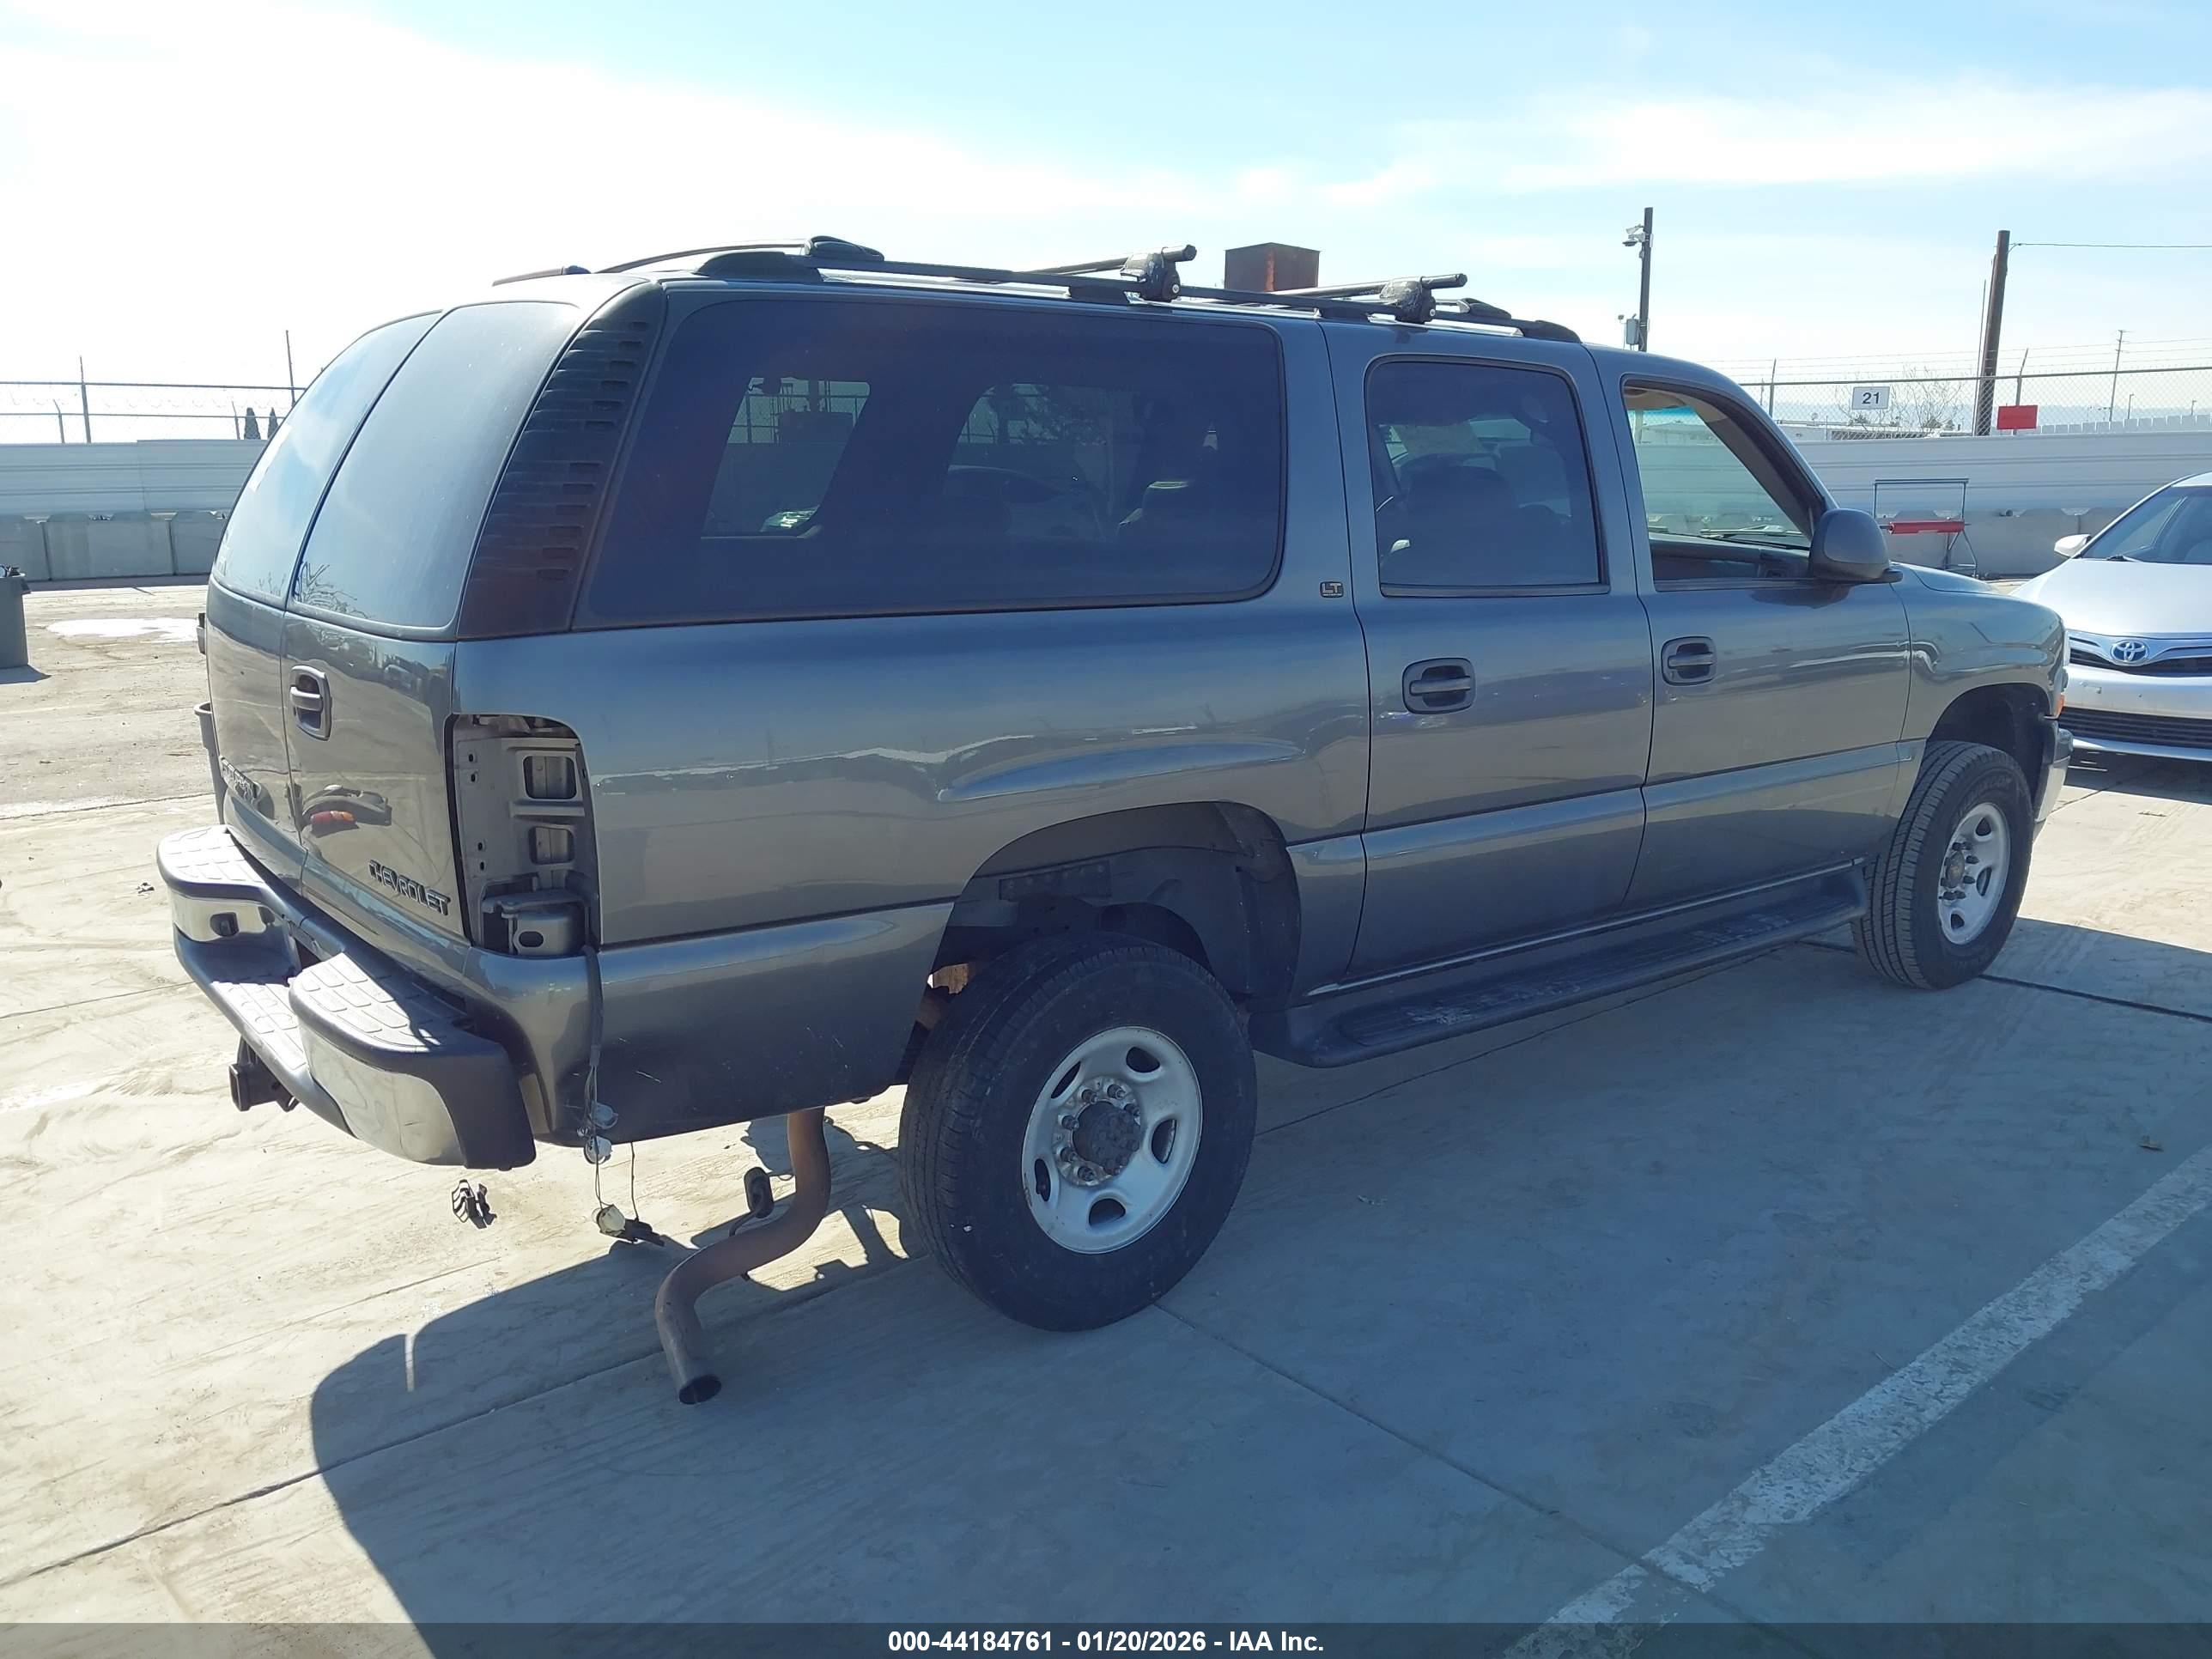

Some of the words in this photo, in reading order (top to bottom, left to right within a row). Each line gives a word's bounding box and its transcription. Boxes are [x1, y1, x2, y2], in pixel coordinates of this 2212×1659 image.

[1862, 392, 1880, 404] 21
[1322, 582, 1342, 593] LT
[368, 859, 451, 916] CHEVROLET
